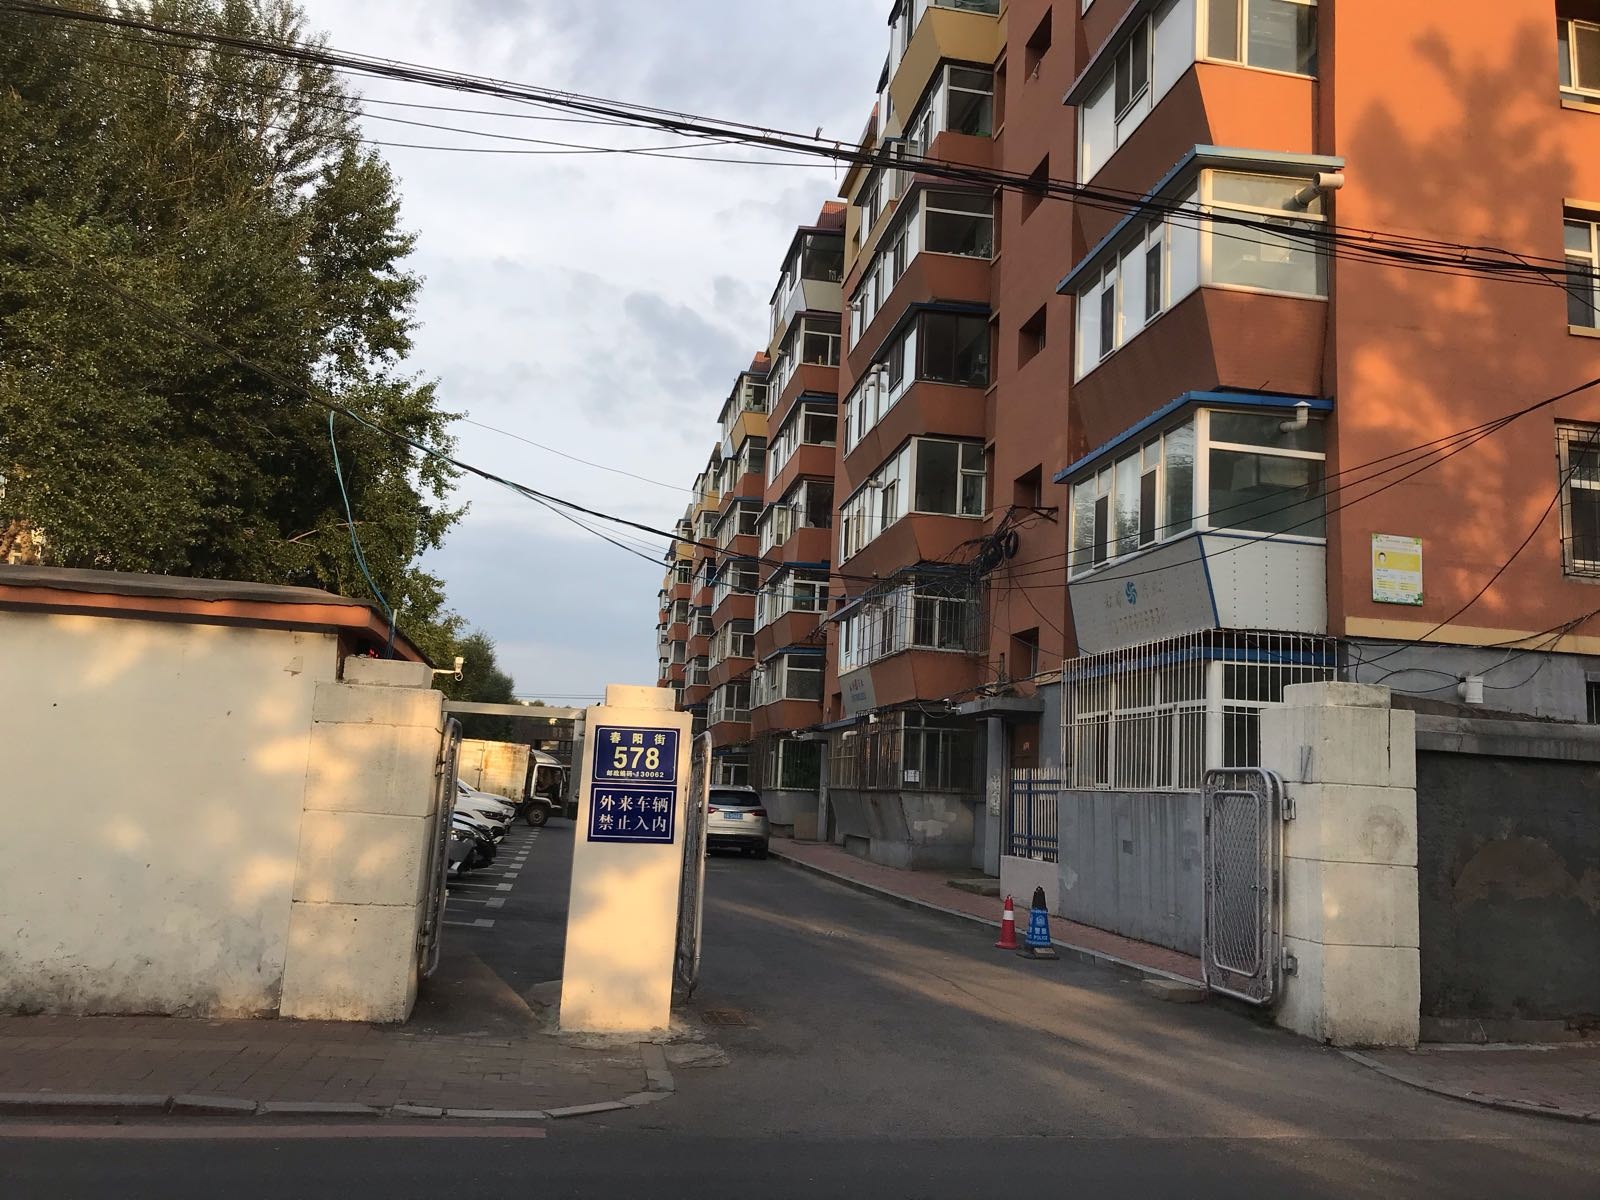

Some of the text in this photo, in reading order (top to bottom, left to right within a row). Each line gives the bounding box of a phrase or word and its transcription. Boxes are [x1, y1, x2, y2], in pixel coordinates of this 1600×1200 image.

[609, 731, 666, 746] 春阳街
[613, 746, 660, 770] 578
[599, 794, 669, 814] 外来车辆
[598, 813, 667, 832] 禁止入内
